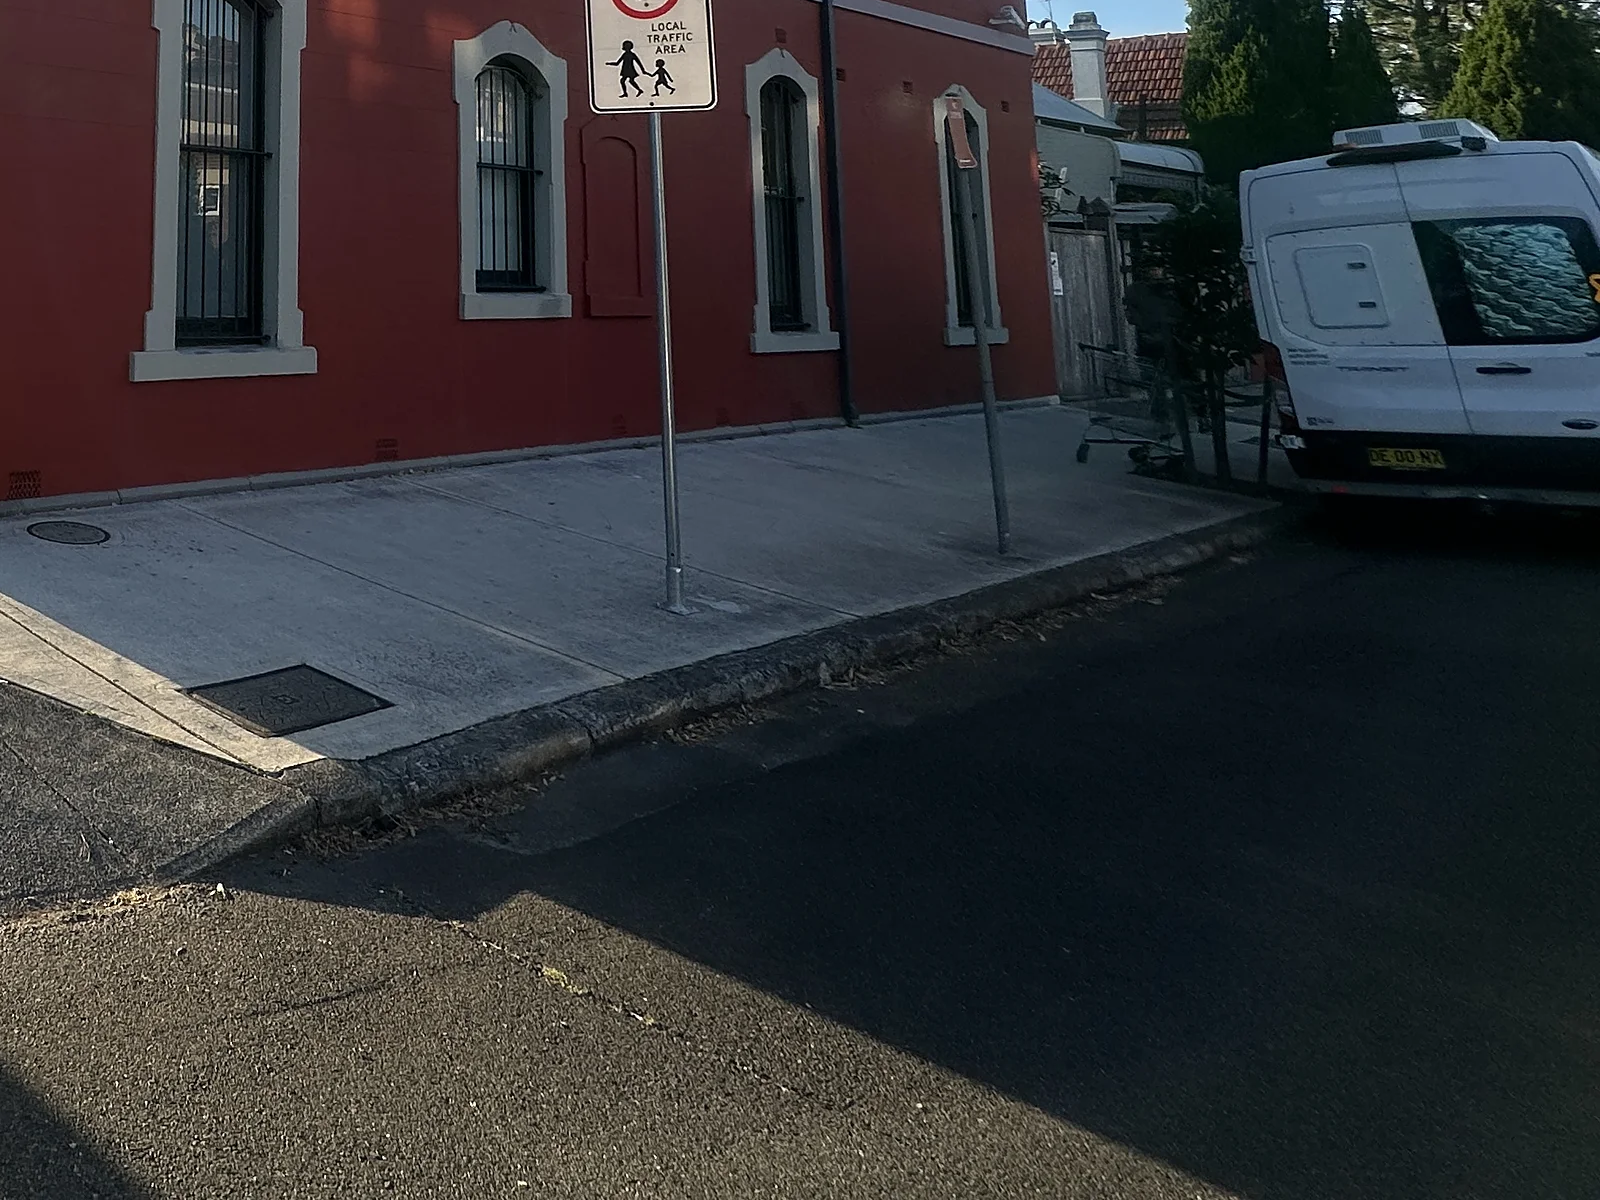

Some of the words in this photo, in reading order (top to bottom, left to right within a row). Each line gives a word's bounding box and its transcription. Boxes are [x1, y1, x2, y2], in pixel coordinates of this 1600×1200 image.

[651, 21, 687, 32] LOCAL
[647, 32, 693, 43] TRAFFIC
[655, 44, 686, 54] AREA
